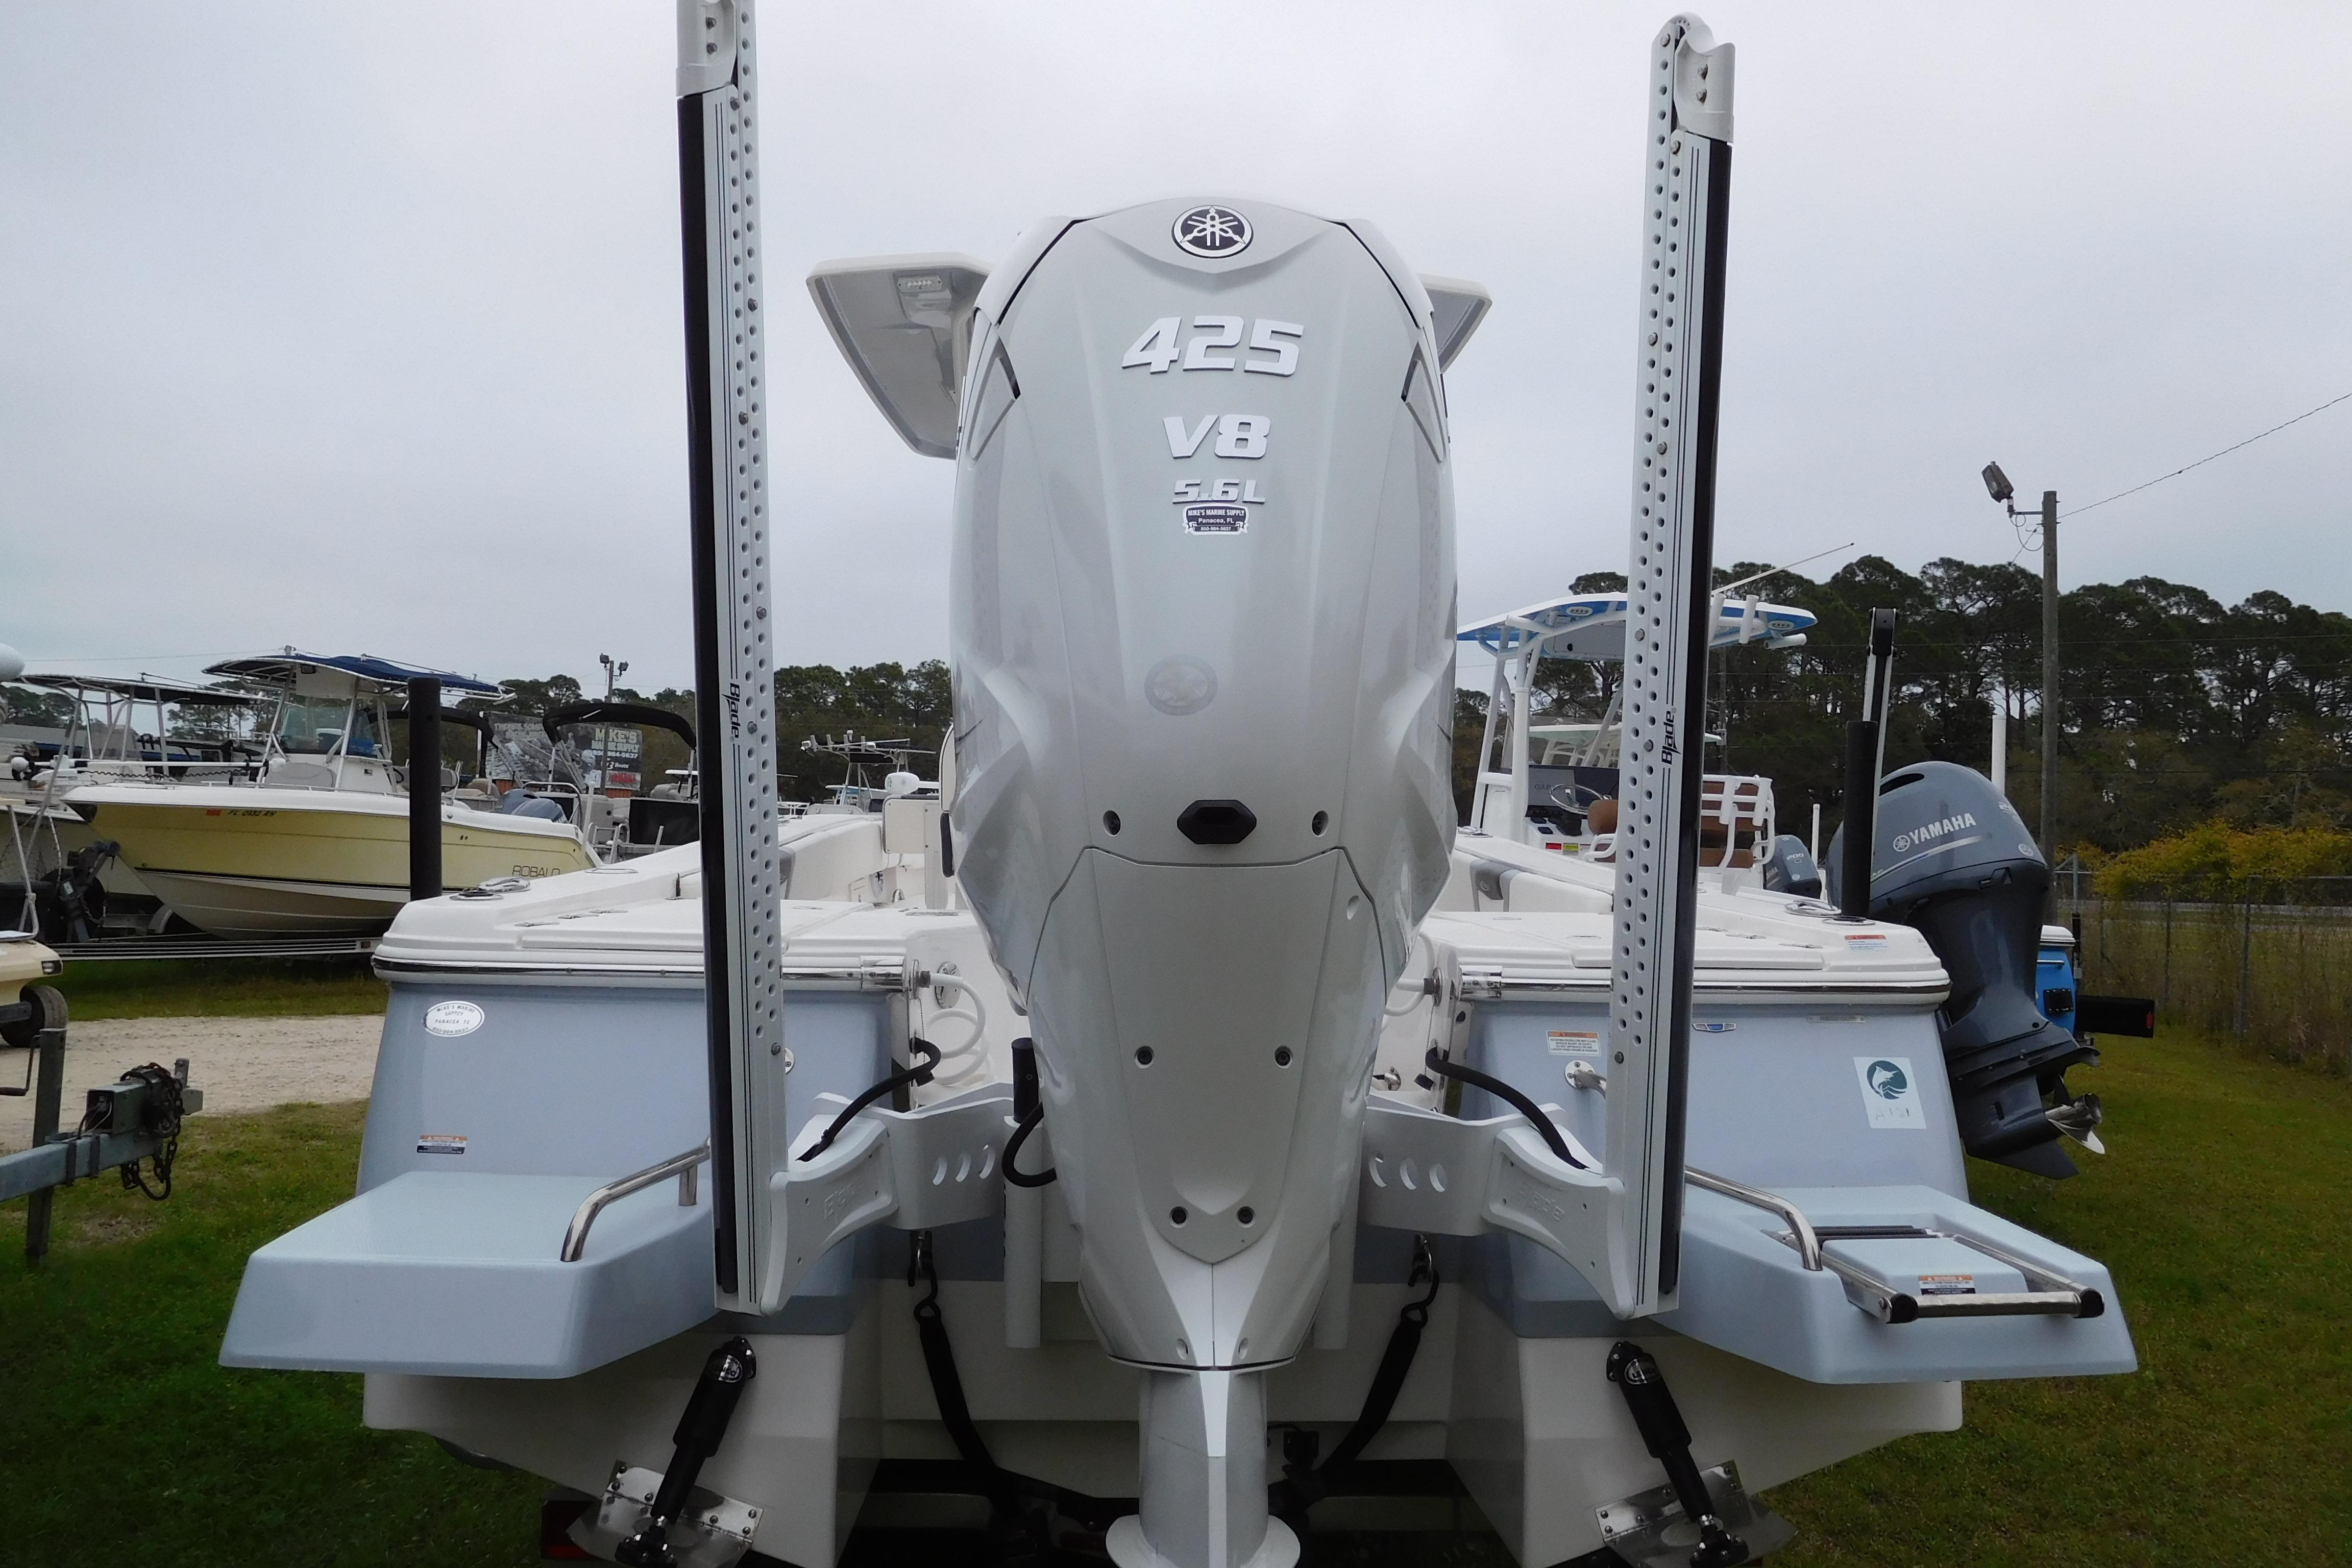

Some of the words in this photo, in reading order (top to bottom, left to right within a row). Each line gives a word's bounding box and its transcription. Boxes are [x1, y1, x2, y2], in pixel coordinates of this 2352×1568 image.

[1121, 315, 1304, 377] 425
[1163, 414, 1270, 459] V8
[1172, 479, 1266, 504] 5.6L
[722, 682, 741, 738] Blade
[595, 728, 637, 744] MKE'S
[1661, 710, 1681, 765] Blade
[1908, 813, 1977, 845] YAMAHA
